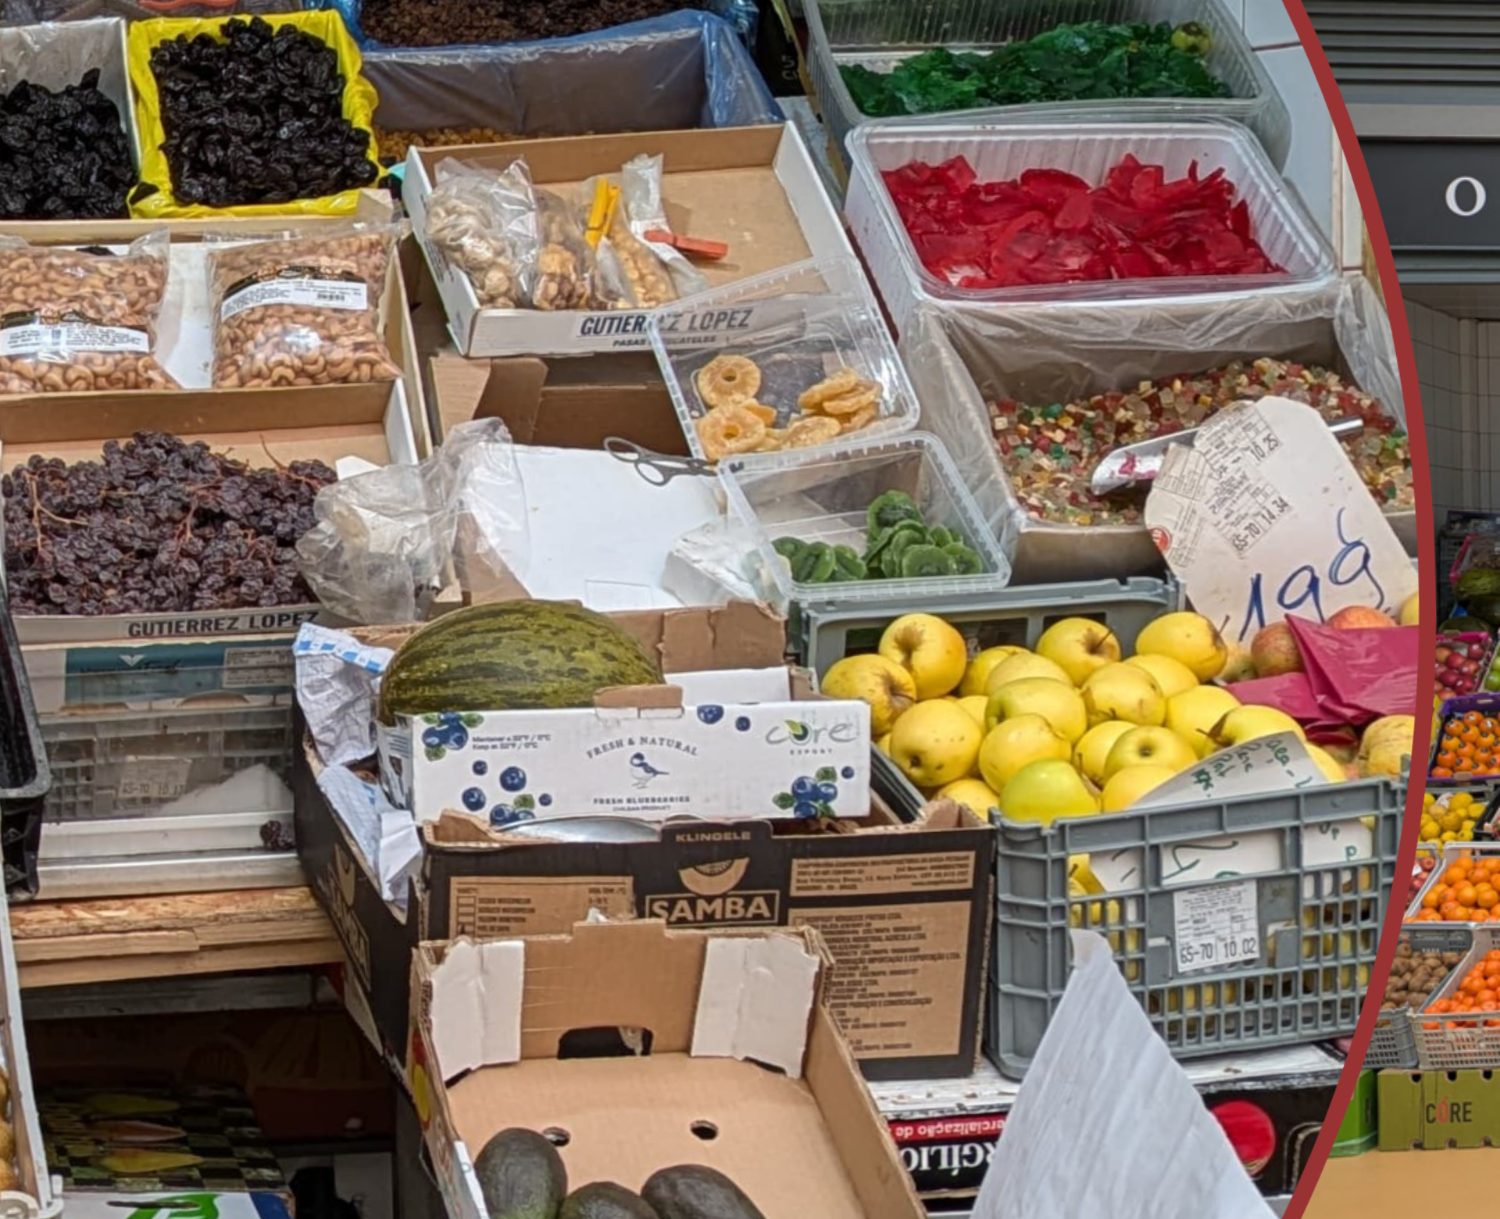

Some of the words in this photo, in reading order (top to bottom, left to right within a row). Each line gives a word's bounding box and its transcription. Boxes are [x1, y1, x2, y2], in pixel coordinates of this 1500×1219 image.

[1445, 176, 1487, 217] O
[688, 309, 755, 331] LOPEZ
[128, 617, 240, 637] GUTIERREZ
[249, 612, 319, 629] LOPEZ
[586, 739, 624, 759] FRESH
[627, 737, 636, 746] &
[639, 736, 698, 757] NATURAL
[651, 897, 772, 922] SAMBA
[1180, 943, 1214, 964] 65-70
[1223, 938, 1258, 958] 10.02
[1425, 1096, 1473, 1124] CÓRE
[895, 1126, 914, 1139] de
